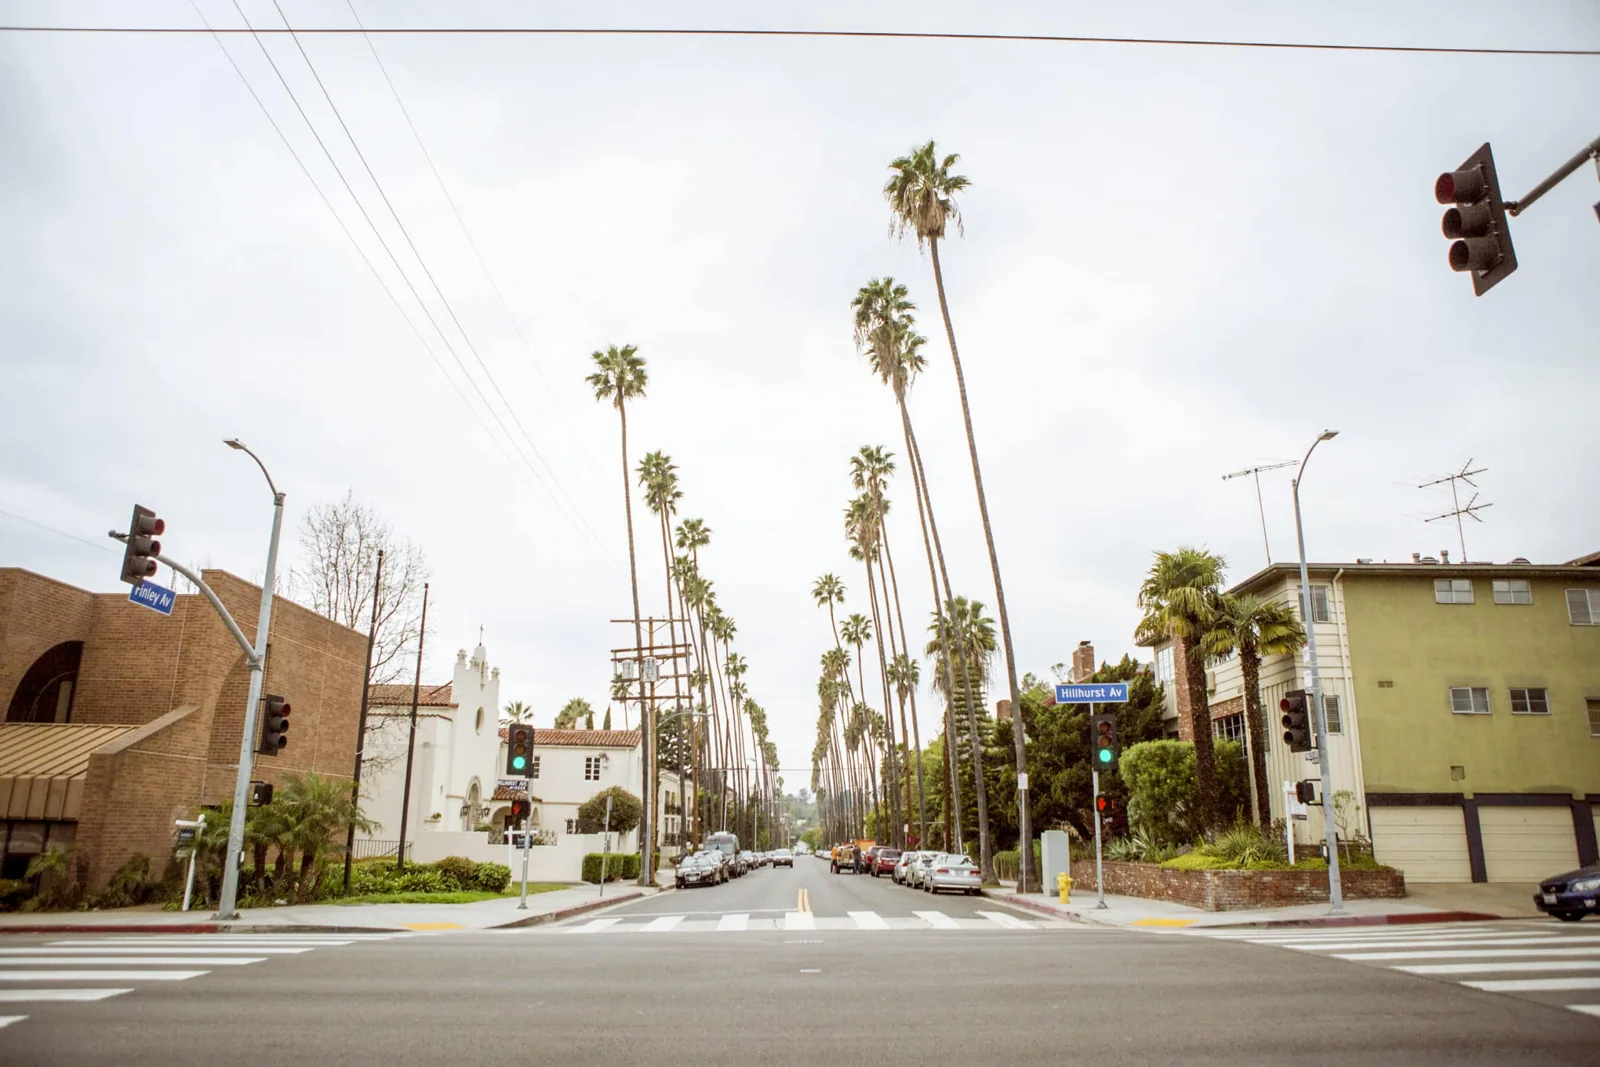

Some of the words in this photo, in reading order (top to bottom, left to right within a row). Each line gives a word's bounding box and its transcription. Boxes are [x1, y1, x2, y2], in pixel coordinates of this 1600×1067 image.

[159, 593, 171, 607] Av
[1061, 687, 1105, 698] Hillhurst
[1109, 687, 1122, 698] Av
